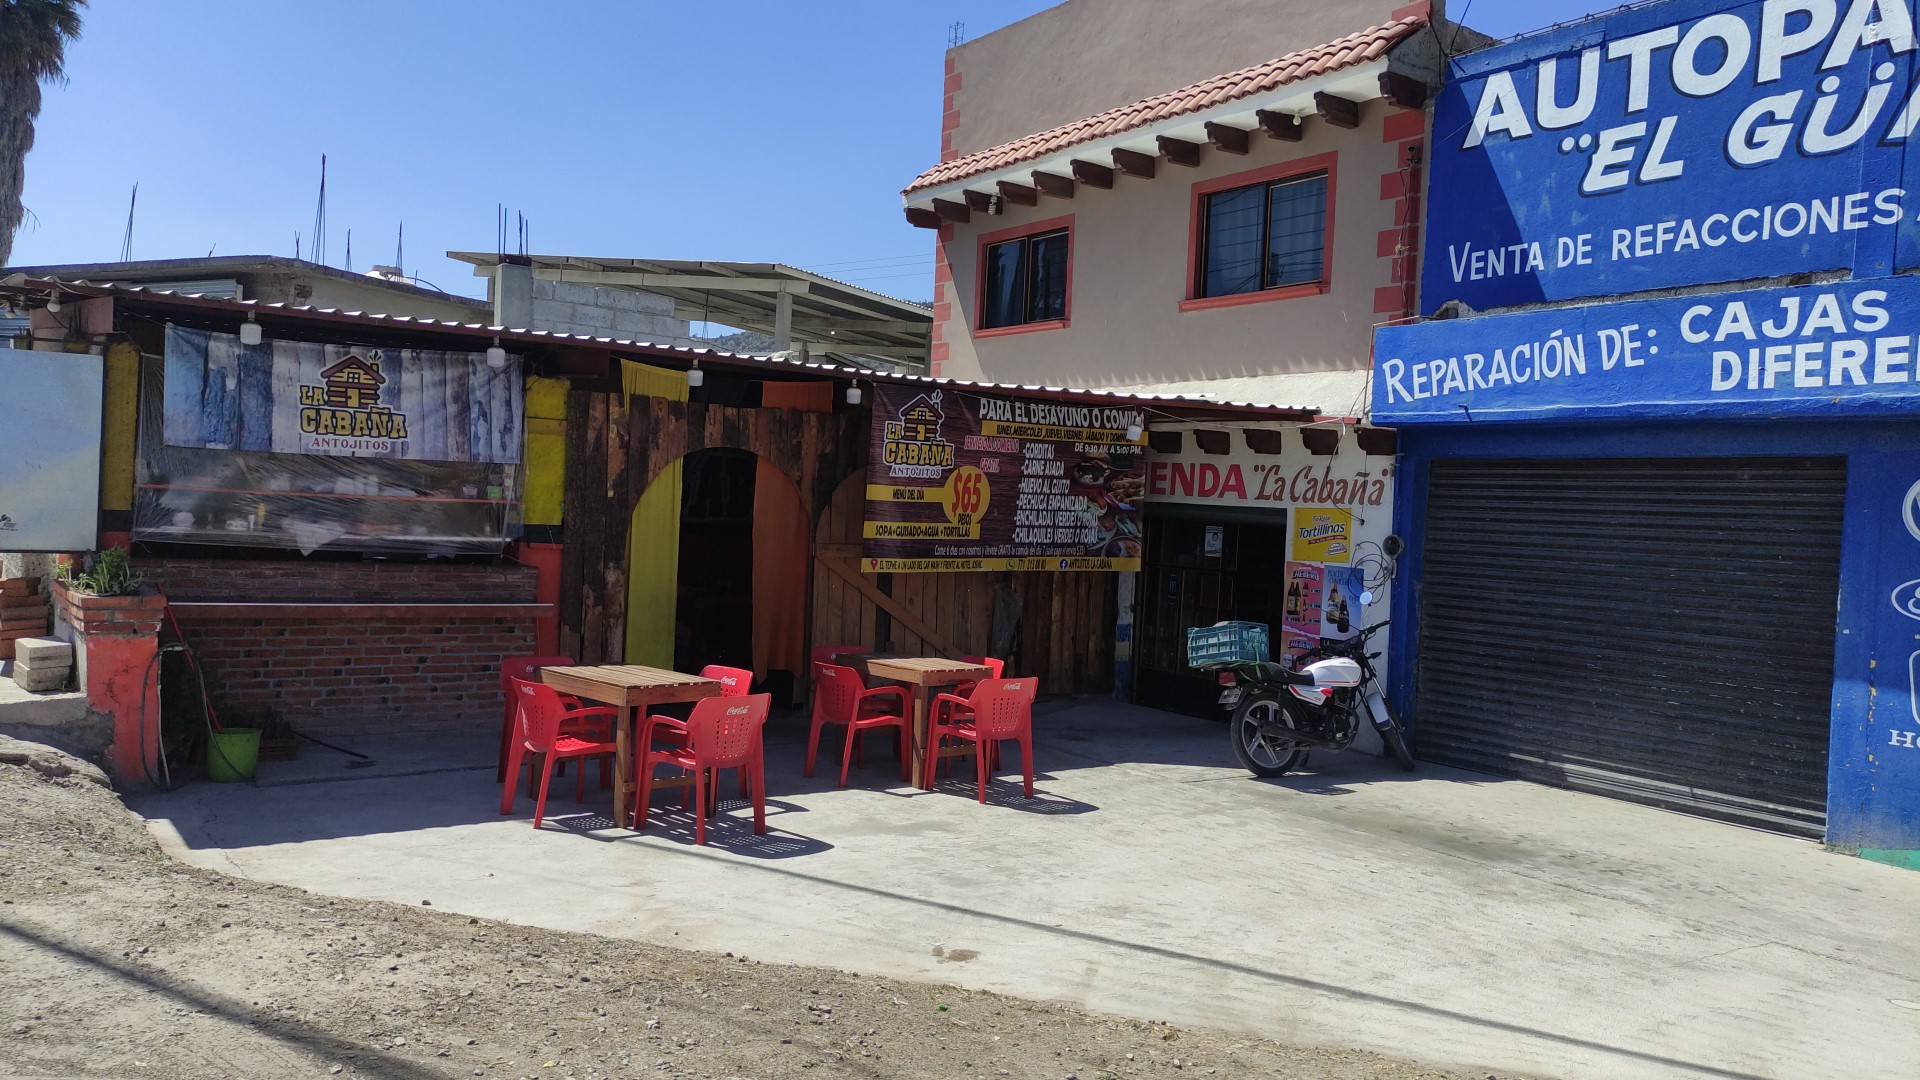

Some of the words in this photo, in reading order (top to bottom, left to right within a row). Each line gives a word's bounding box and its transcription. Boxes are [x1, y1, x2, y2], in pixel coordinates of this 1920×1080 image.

[1557, 233, 1592, 268] DE
[1611, 188, 1907, 261] REFACCIONES
[1680, 290, 1890, 343] CAJAS
[1597, 323, 1658, 371] DE:
[300, 385, 325, 406] LA
[978, 398, 1012, 421] PARA
[1015, 402, 1028, 423] EL
[1031, 403, 1090, 427] DESAYUNO
[1092, 409, 1101, 428] O
[300, 406, 407, 439] CABAÑA
[885, 422, 902, 440] LA
[312, 437, 389, 450] ANTOJITOS
[1074, 442, 1083, 452] DE
[885, 439, 953, 467] CABAÑA
[891, 466, 941, 477] ANTOJITOS
[1044, 461, 1064, 477] ASADA
[1042, 479, 1051, 494] AL
[1051, 480, 1070, 495] GUSTO
[1147, 461, 1248, 500] ENDA
[908, 488, 916, 500] DEL
[951, 469, 982, 517] $65
[1048, 495, 1088, 511] EMPANIZADA
[958, 513, 972, 526] PESOS
[1055, 511, 1077, 527] VERDES
[1055, 528, 1075, 544] VERDES
[1299, 523, 1345, 539] Tortillinas
